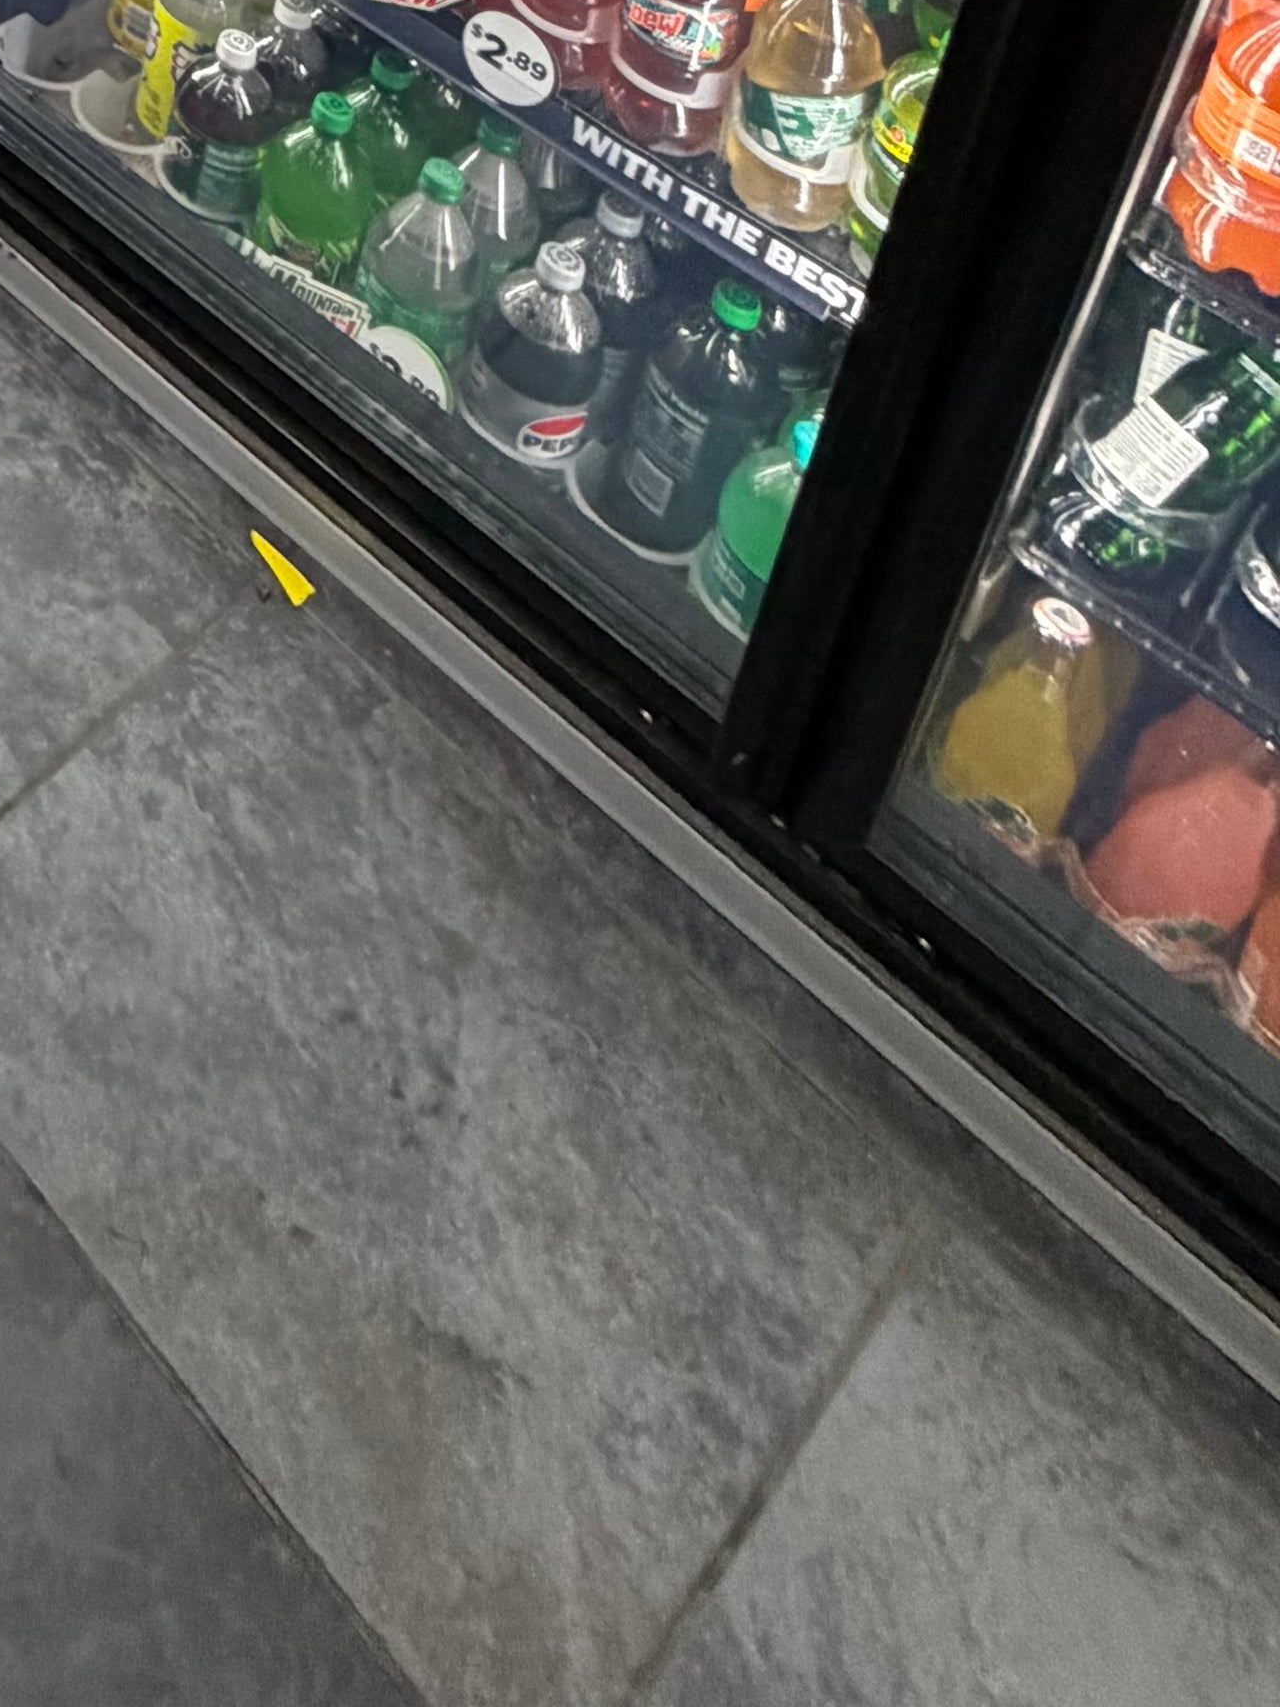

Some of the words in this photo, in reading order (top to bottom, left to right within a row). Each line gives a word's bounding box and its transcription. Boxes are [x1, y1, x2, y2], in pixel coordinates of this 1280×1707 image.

[471, 21, 550, 82] $2.89
[570, 116, 675, 204] WITH
[678, 185, 762, 257] THE
